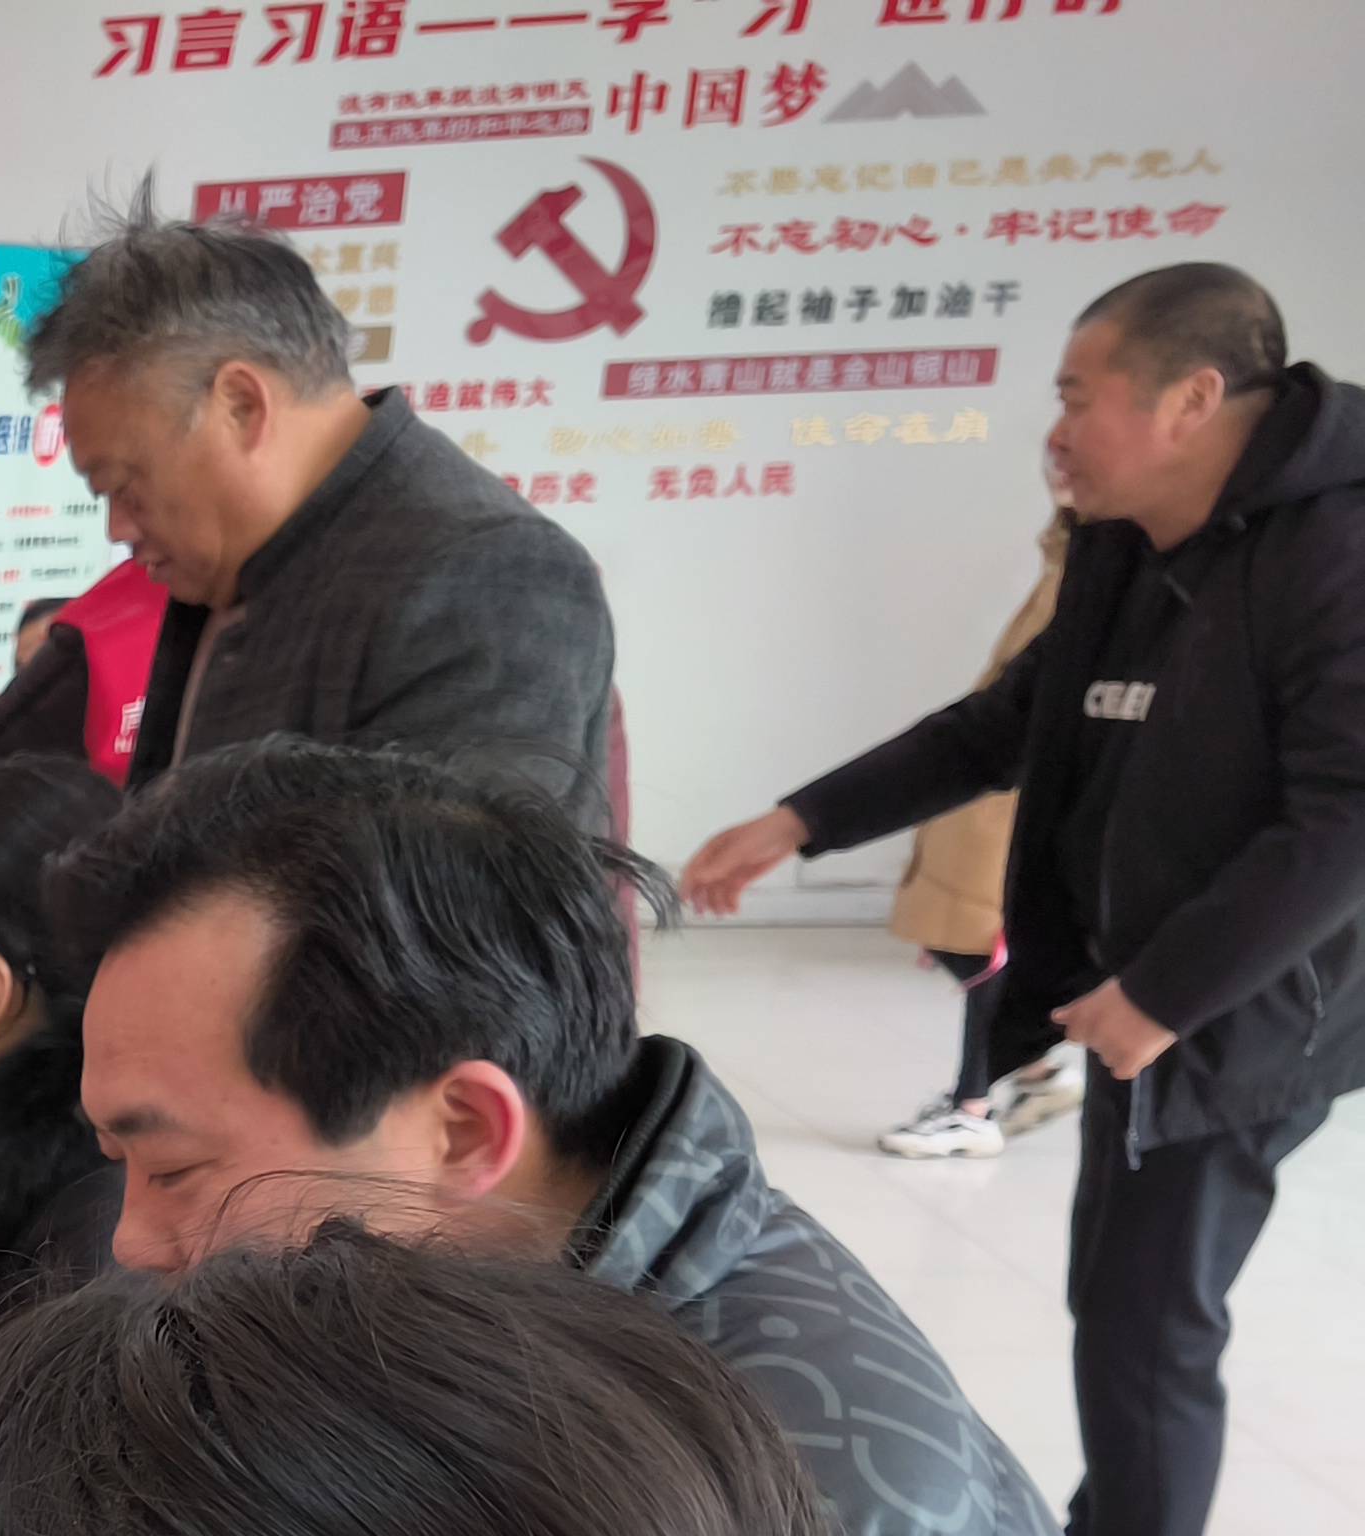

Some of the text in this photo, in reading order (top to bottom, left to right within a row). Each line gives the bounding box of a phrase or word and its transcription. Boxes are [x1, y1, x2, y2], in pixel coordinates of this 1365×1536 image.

[606, 62, 827, 134] 中国梦
[716, 146, 1225, 199] 不要忘记自己是共产党人
[217, 179, 386, 226] 从严治党
[706, 279, 1022, 328] 撸起袖子加油干
[628, 349, 982, 397] 绿水青山就是金山银山
[790, 408, 991, 448] 使命在肩
